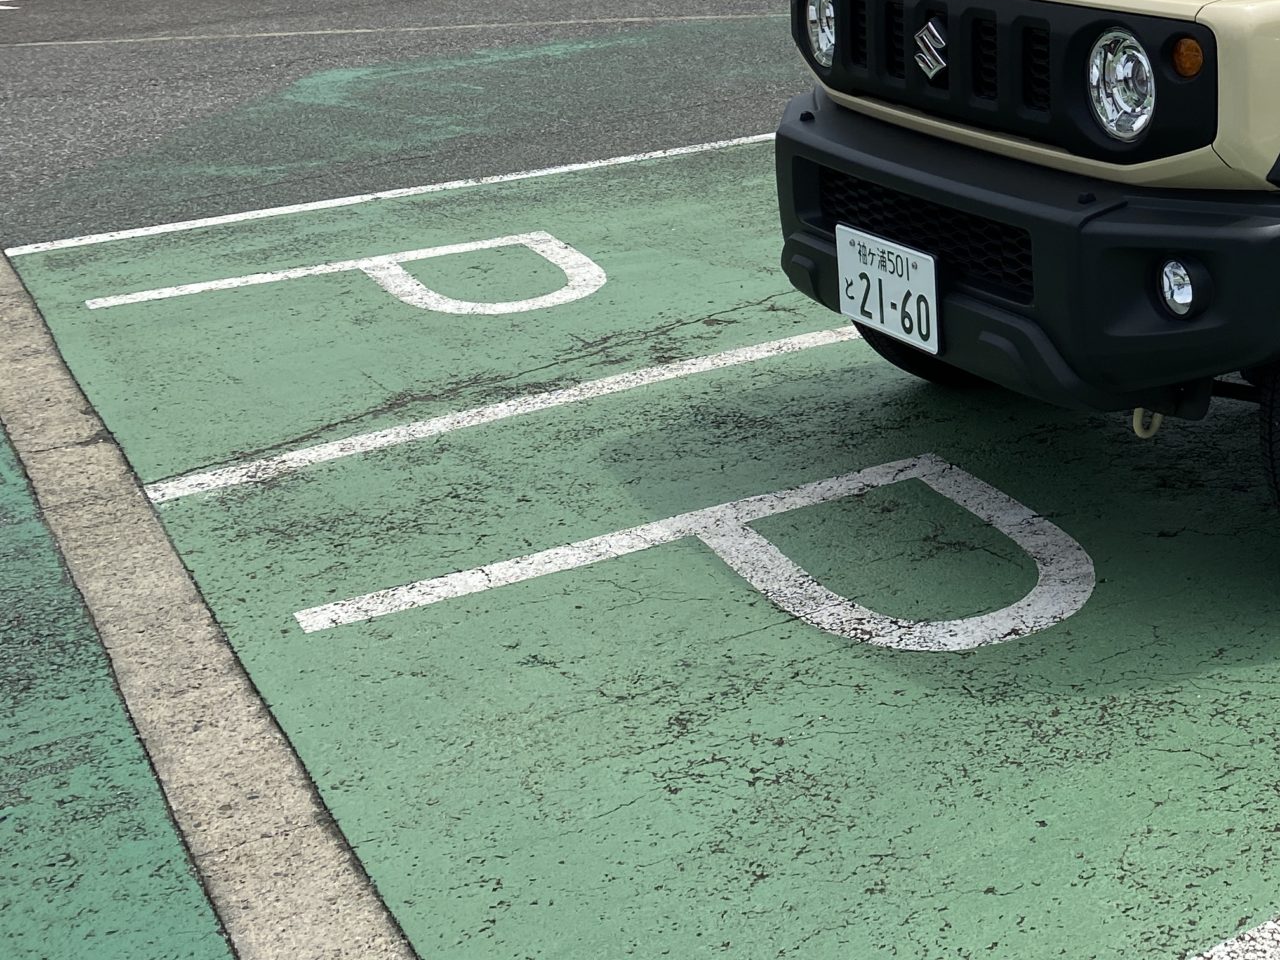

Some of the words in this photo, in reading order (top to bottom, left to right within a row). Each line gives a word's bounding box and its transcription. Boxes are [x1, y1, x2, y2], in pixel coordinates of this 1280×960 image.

[85, 230, 607, 315] P
[844, 277, 855, 301] と
[858, 271, 931, 343] 21-60
[293, 454, 1097, 653] P
